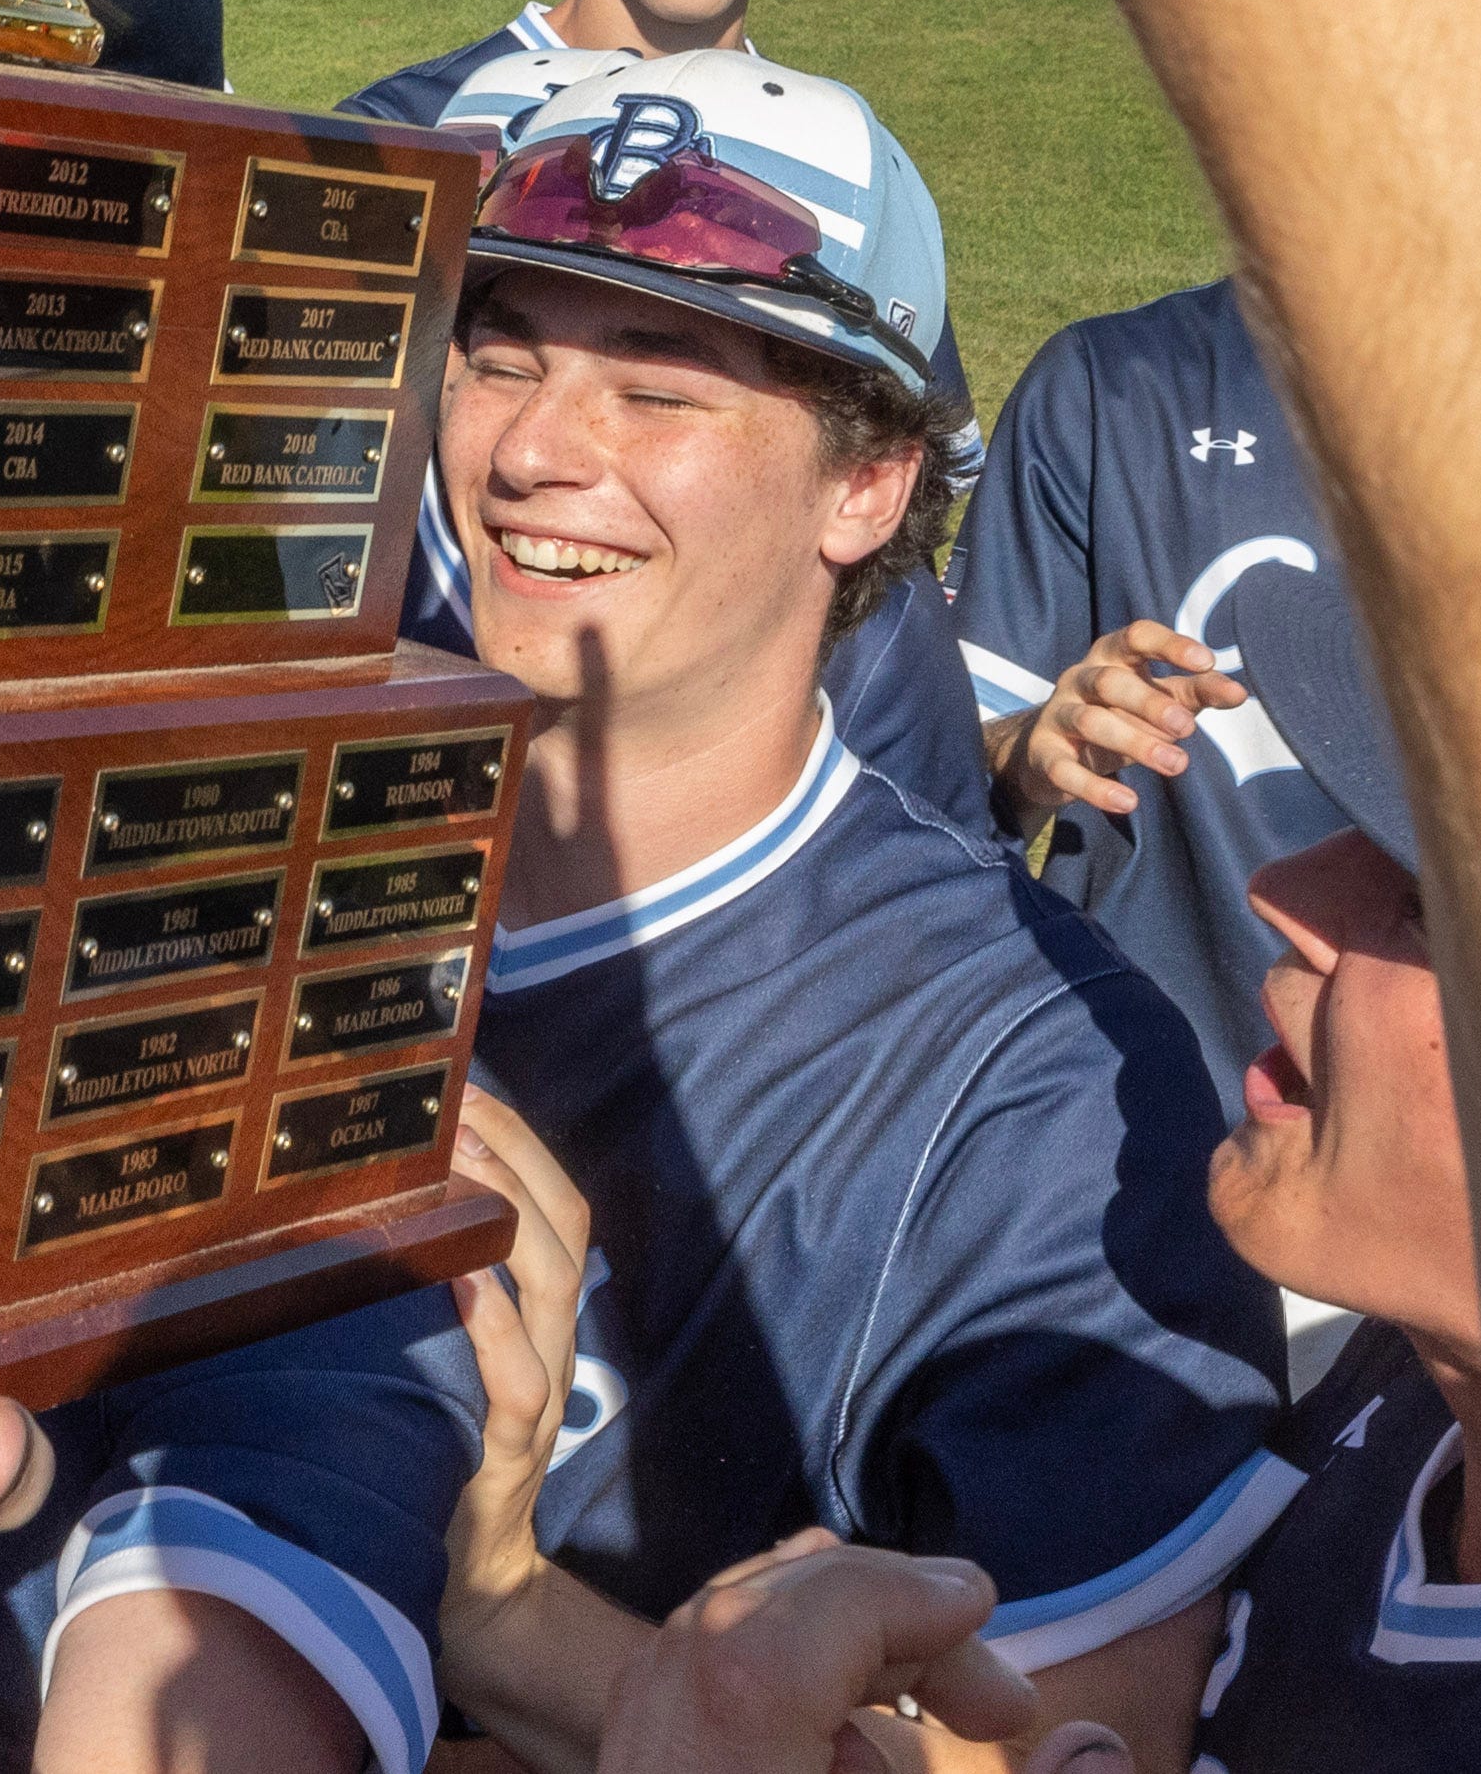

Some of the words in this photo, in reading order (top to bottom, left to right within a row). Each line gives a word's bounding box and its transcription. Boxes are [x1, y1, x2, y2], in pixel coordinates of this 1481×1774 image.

[49, 160, 88, 184] 2012
[323, 188, 355, 210] 2016
[92, 201, 130, 225] TWP.
[320, 219, 349, 242] CBA
[26, 293, 66, 317] 2013
[302, 309, 335, 328] 2017
[41, 330, 128, 354] CATHOLIC
[239, 337, 271, 359] RED
[273, 338, 310, 360] BANK
[313, 340, 384, 362] CATHOLIC
[5, 423, 44, 445] 2014
[283, 434, 316, 454] 2018
[3, 457, 38, 480] CBA
[221, 463, 251, 485] RED
[255, 464, 291, 486] BANK
[295, 464, 366, 486] CATHOLIC
[409, 751, 441, 773] 1984
[385, 778, 454, 806] RUMSON
[110, 813, 223, 851] MIDDLETOWN
[225, 806, 281, 834] SOUTH
[161, 908, 199, 934] 1981
[325, 902, 415, 936] MIDDLETOWN
[418, 894, 466, 921] NORTH
[90, 936, 203, 975] MIDDLETOWN
[207, 926, 262, 958] SOUTH
[334, 999, 424, 1035] MARLBORO
[139, 1033, 177, 1058] 1982
[66, 1062, 178, 1106] MIDDLETOWN
[182, 1049, 240, 1085] NORTH
[347, 1092, 380, 1116] 1987
[329, 1118, 385, 1149] OCEAN
[119, 1147, 158, 1174] 1983
[76, 1170, 187, 1218] MARLBORO
